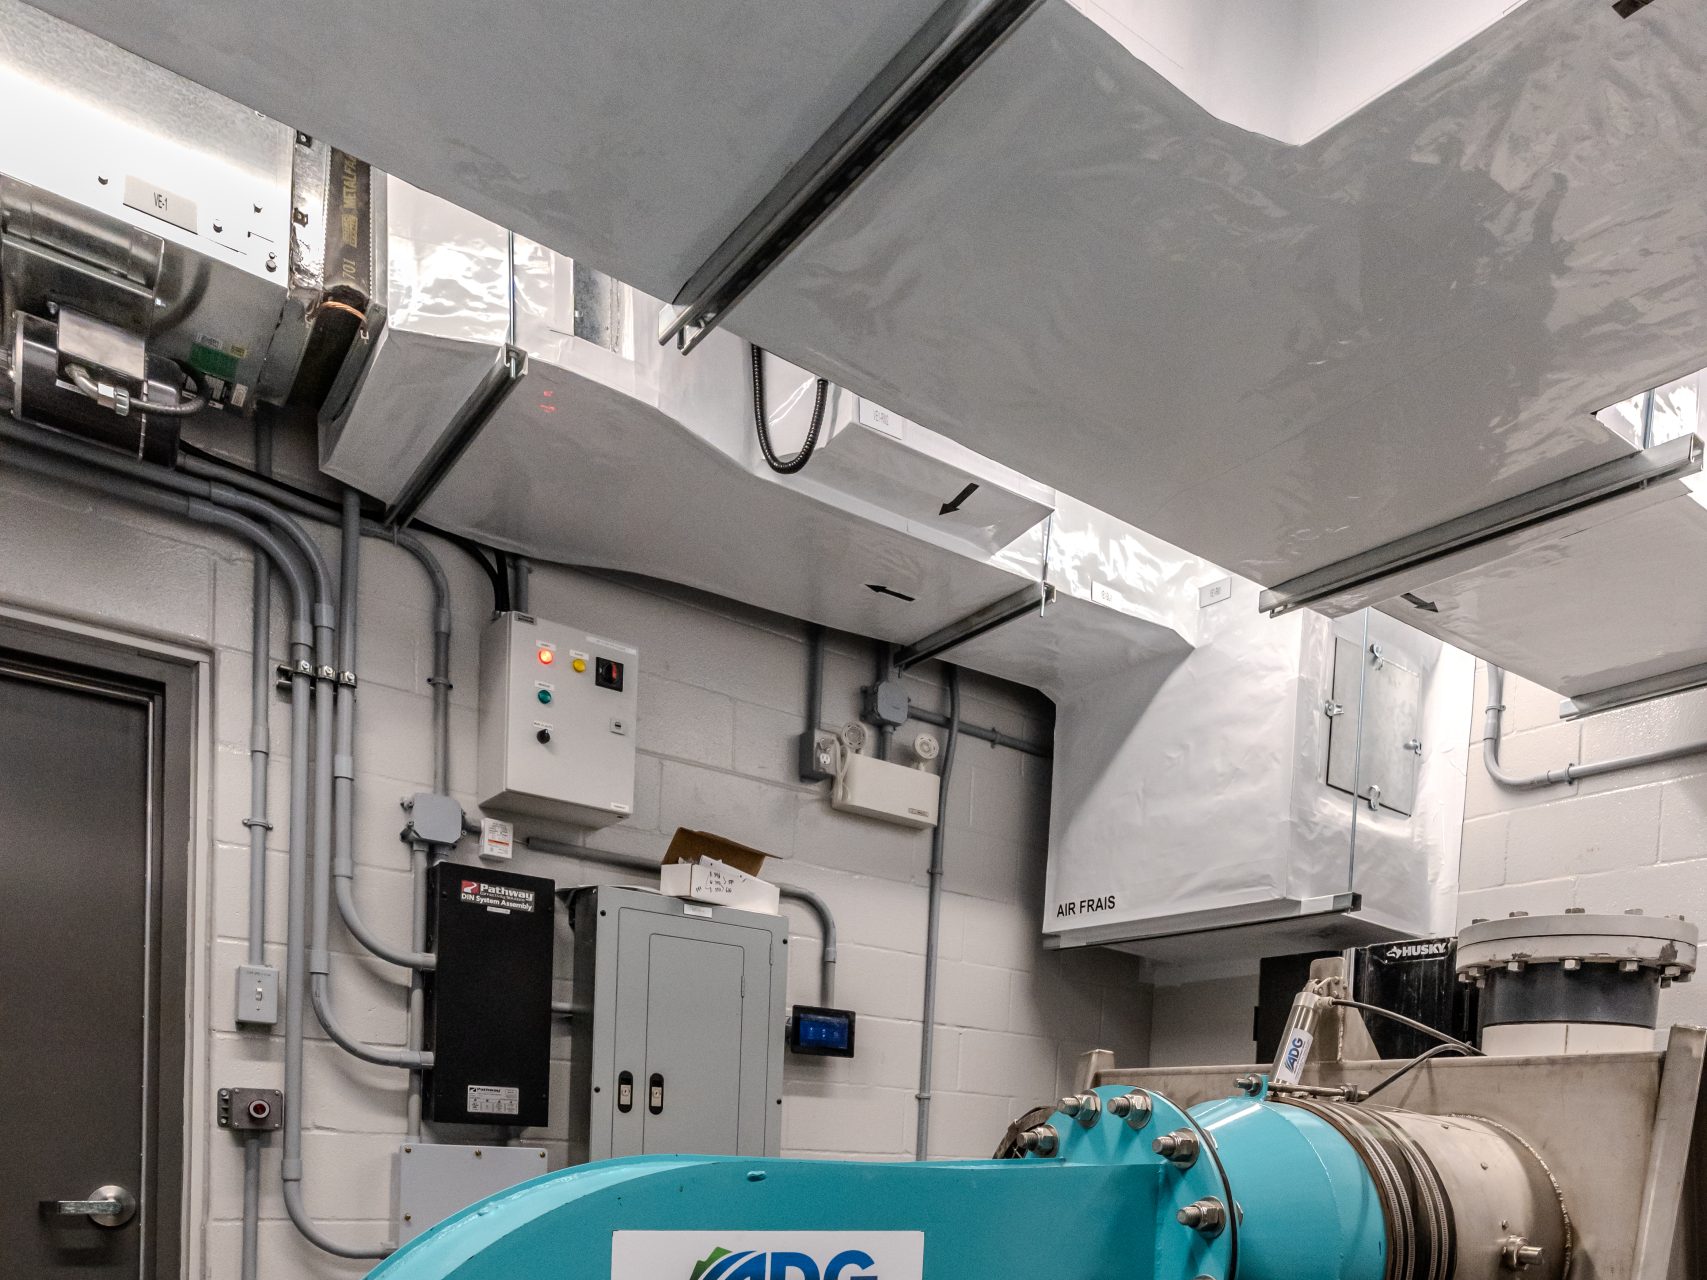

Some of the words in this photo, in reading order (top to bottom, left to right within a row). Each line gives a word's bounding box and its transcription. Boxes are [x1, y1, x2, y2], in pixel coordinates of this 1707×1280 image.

[153, 191, 168, 212] VE-1
[461, 893, 475, 901] DIN
[476, 895, 500, 904] System
[501, 899, 533, 912] Assembly
[480, 883, 533, 902] Pathway
[1056, 902, 1076, 918] AIR
[1079, 895, 1116, 913] FRAIS
[1402, 943, 1447, 957] HUSKY
[1285, 1037, 1303, 1073] ADG
